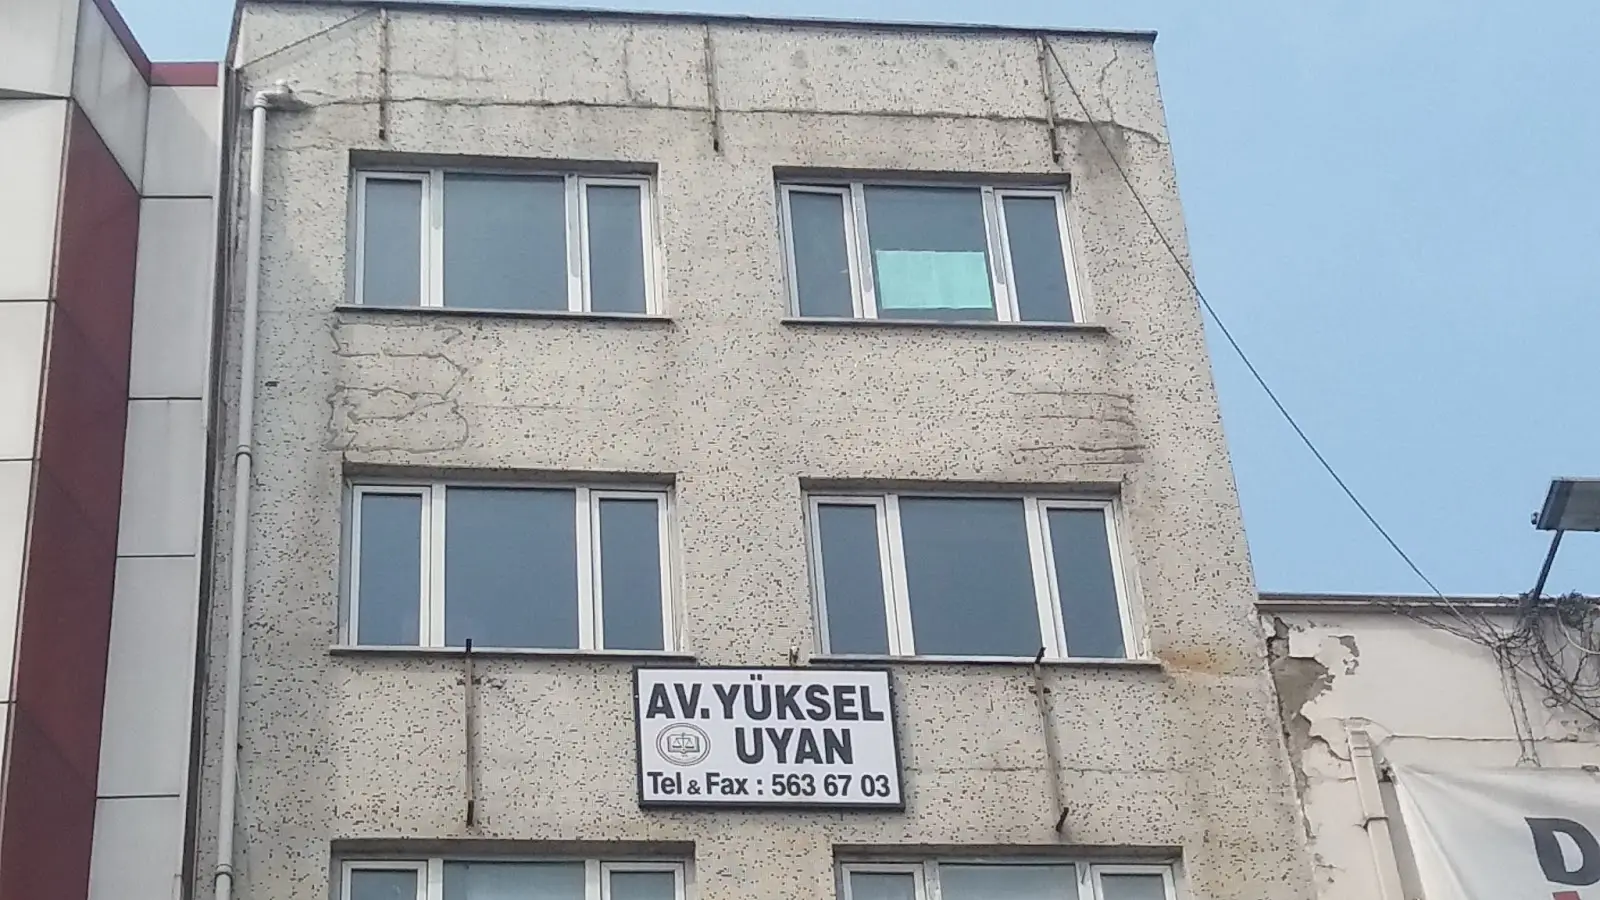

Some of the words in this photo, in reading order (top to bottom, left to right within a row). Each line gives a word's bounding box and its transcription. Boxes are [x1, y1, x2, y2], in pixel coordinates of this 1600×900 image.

[735, 727, 854, 765] UYAN
[772, 773, 816, 797] 563
[824, 774, 852, 797] 67
[861, 775, 890, 798] 03
